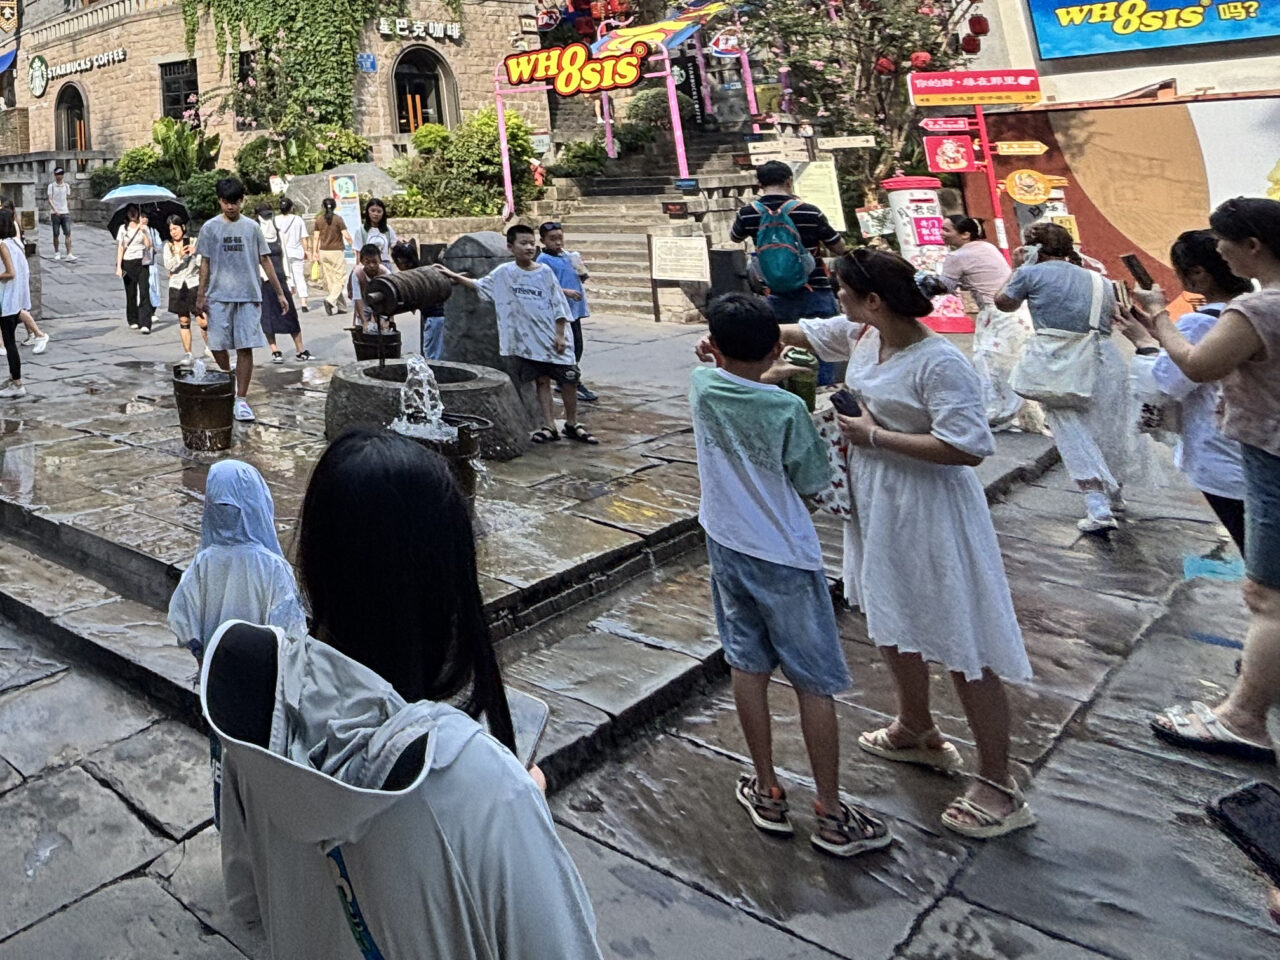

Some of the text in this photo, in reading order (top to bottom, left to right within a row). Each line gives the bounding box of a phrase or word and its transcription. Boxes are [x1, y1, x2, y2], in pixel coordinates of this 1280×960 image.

[379, 17, 461, 39] 星巴克咖啡
[47, 48, 126, 80] STARBUCKS COFFEE
